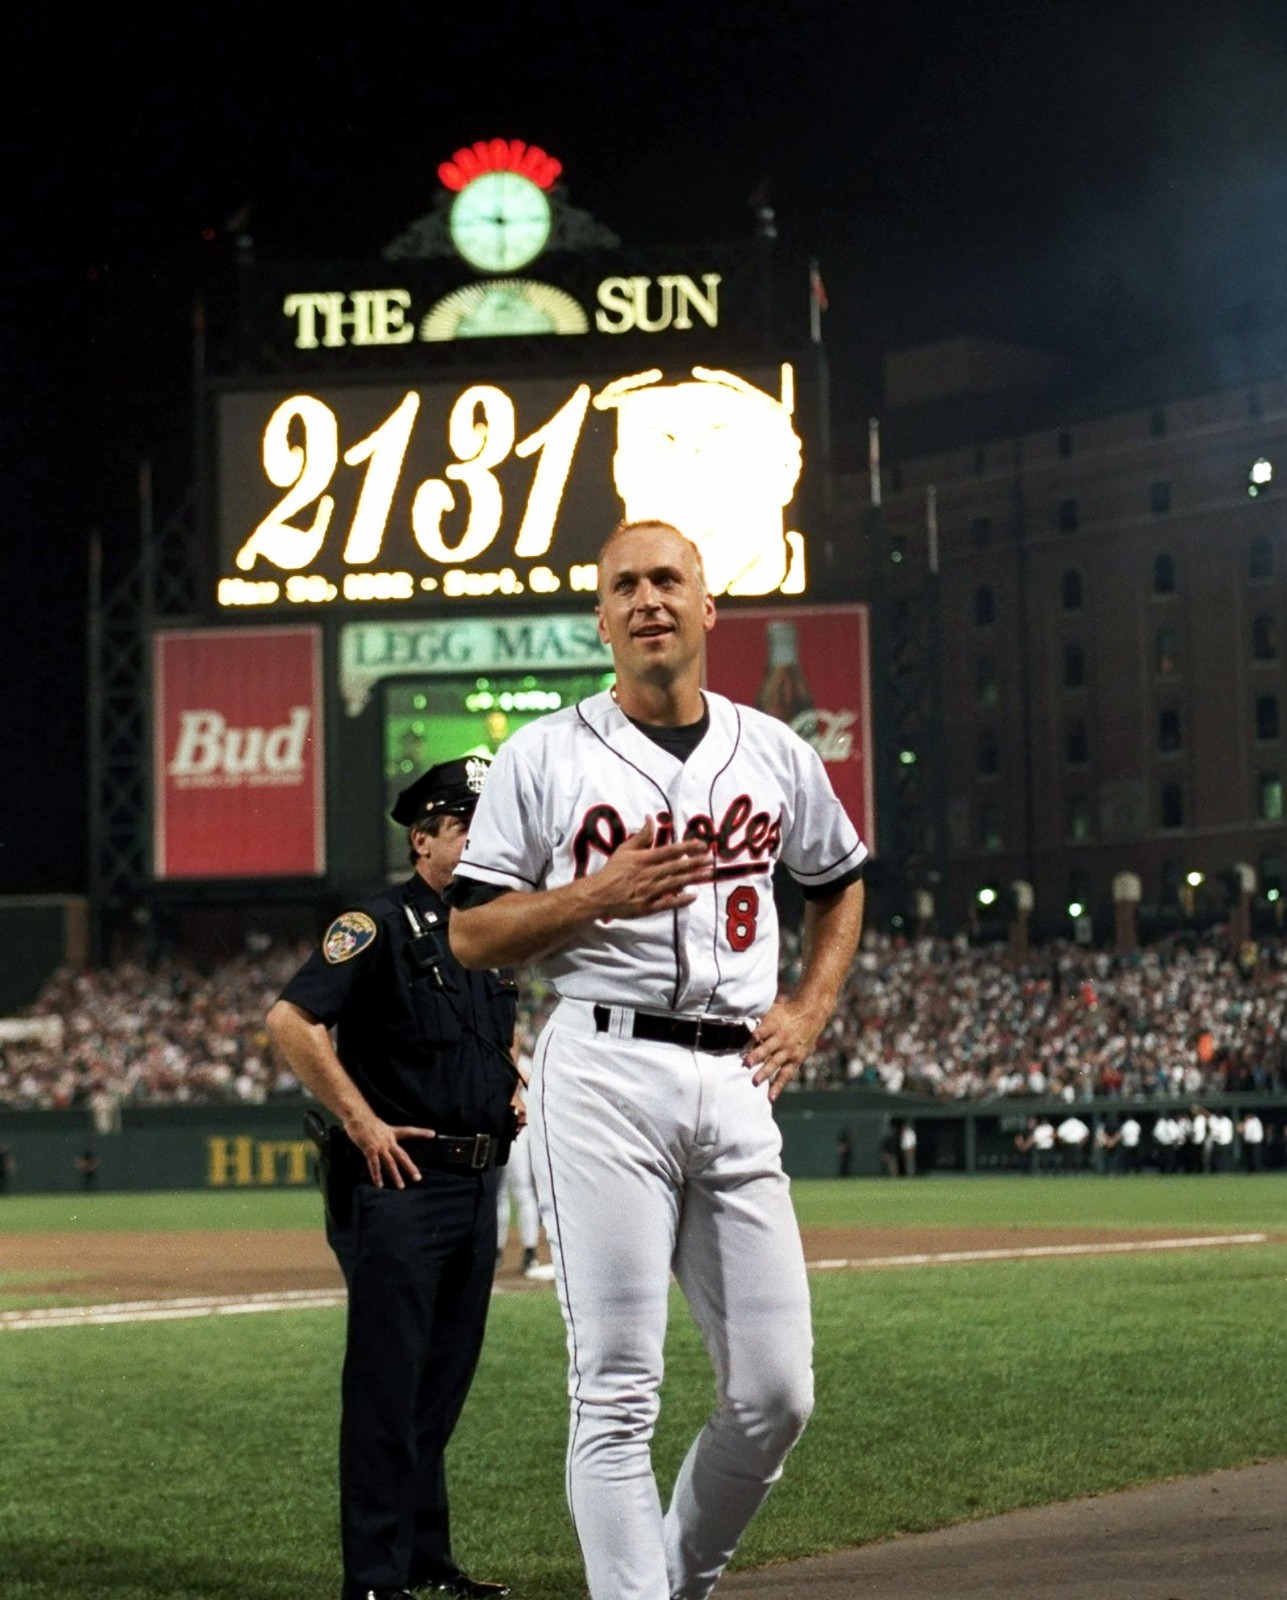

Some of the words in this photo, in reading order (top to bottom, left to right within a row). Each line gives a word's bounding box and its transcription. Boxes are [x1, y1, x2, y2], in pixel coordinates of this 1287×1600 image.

[284, 289, 414, 349] THE
[596, 273, 722, 334] SUN
[236, 383, 591, 571] 2131
[354, 628, 474, 666] LEGG
[494, 623, 612, 662] MAS
[170, 706, 311, 775] Bud
[726, 885, 759, 953] 8
